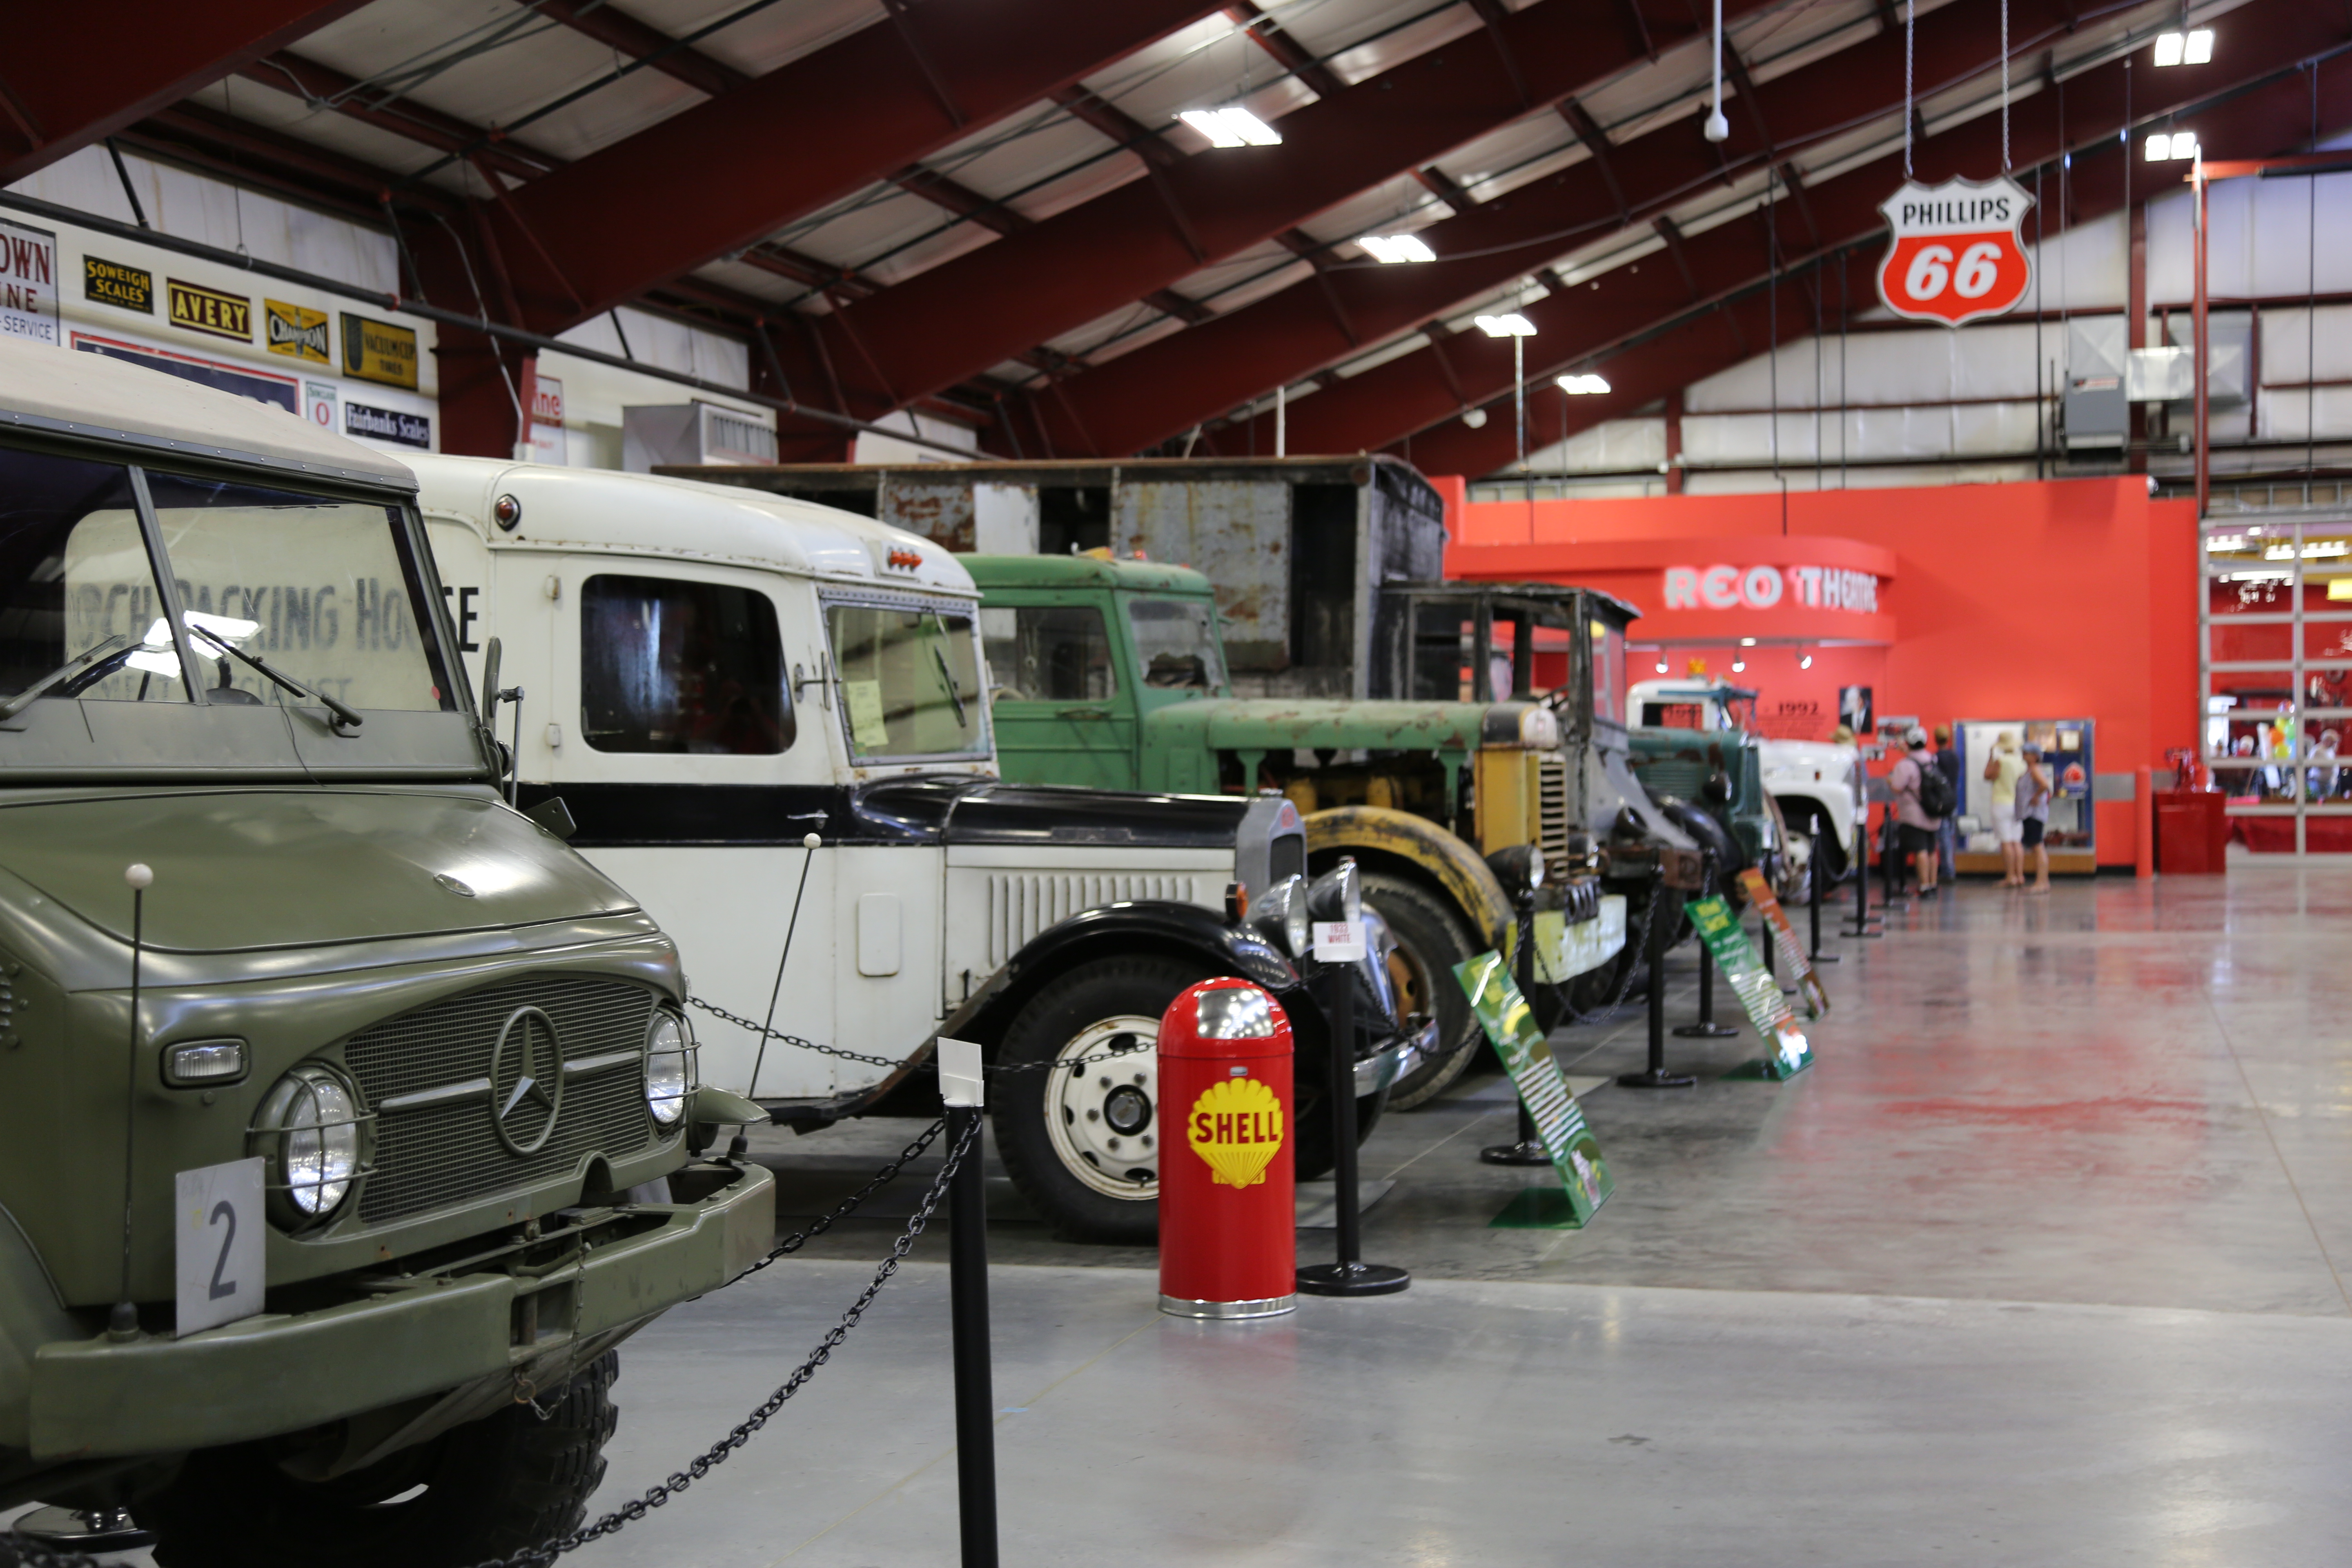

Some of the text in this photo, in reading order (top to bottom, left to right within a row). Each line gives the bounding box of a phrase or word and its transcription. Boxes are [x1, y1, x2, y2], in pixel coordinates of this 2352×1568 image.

[1903, 197, 2009, 227] PHILLIPS
[87, 261, 150, 292] SOWEIGH
[1904, 241, 2003, 302] 66
[0, 282, 38, 314] NE
[96, 279, 145, 303] SCALES
[175, 291, 246, 332] AVERY
[346, 403, 429, 442] Fairbanks Scales
[1664, 565, 1784, 610] REO
[356, 577, 479, 652] HOE
[1327, 933, 1351, 944] WHITE
[1195, 1111, 1278, 1144] SHELL
[209, 1200, 236, 1301] 2
